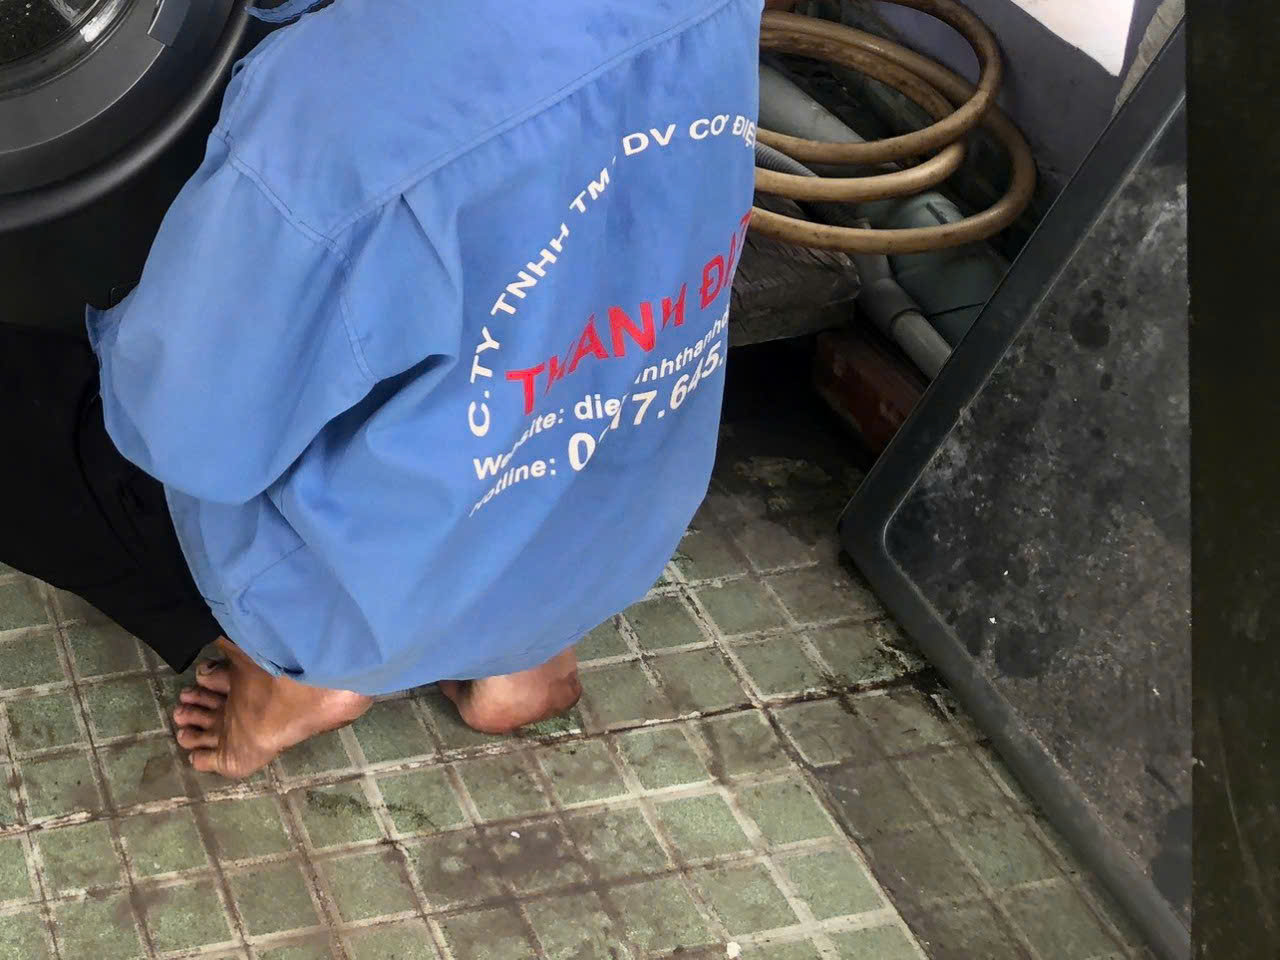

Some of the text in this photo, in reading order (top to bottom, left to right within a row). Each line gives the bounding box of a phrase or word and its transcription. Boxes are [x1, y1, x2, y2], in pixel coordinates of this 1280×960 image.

[467, 113, 756, 437] C.TY TNHH TM DV CƠ ĐIỆ
